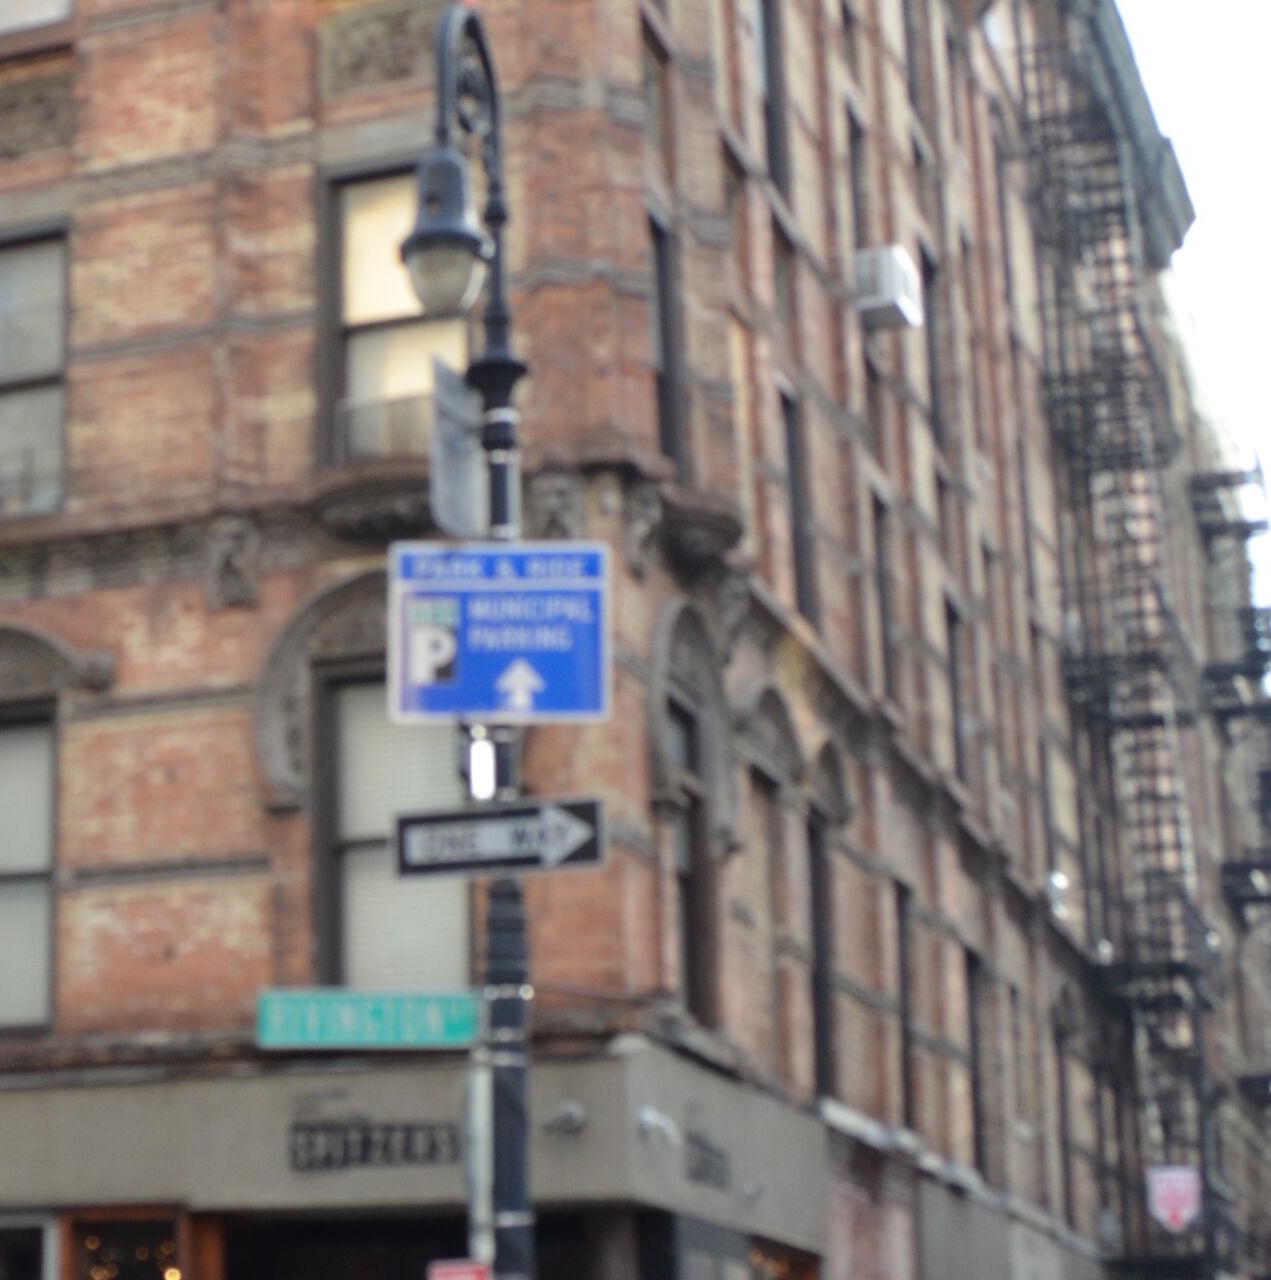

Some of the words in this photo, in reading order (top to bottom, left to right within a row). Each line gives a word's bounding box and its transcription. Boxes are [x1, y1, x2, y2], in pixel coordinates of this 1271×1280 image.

[414, 560, 484, 580] PARK
[498, 560, 517, 579] &
[529, 559, 586, 579] RIDE
[469, 597, 595, 621] MUNICIPAL
[469, 624, 572, 650] PARKING
[423, 827, 481, 857] ONE
[508, 820, 570, 852] WAY
